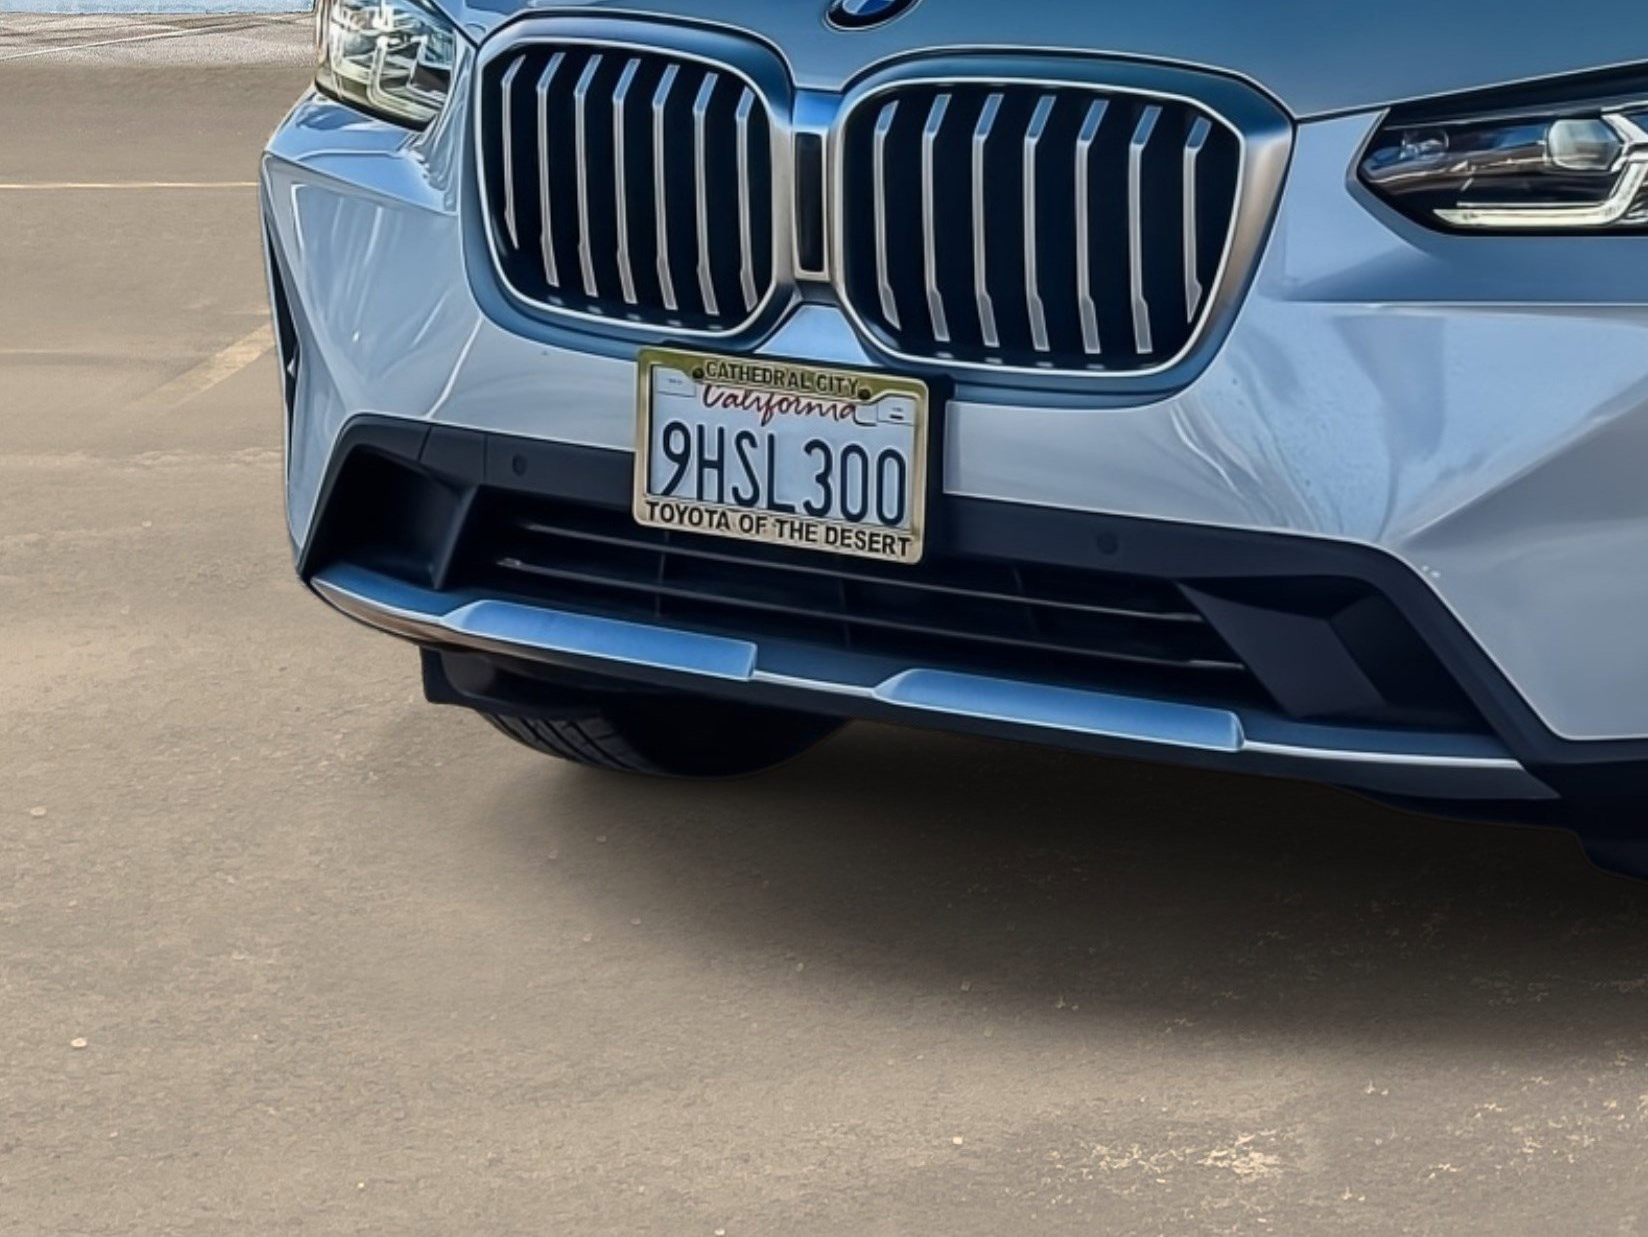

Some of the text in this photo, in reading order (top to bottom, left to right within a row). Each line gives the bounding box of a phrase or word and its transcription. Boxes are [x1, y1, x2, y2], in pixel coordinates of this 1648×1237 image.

[705, 361, 858, 397] CATHEDRAL CITY
[702, 384, 877, 427] California
[662, 420, 907, 526] 9HSL300
[646, 500, 912, 558] TOYOTA OF THE DESERT
